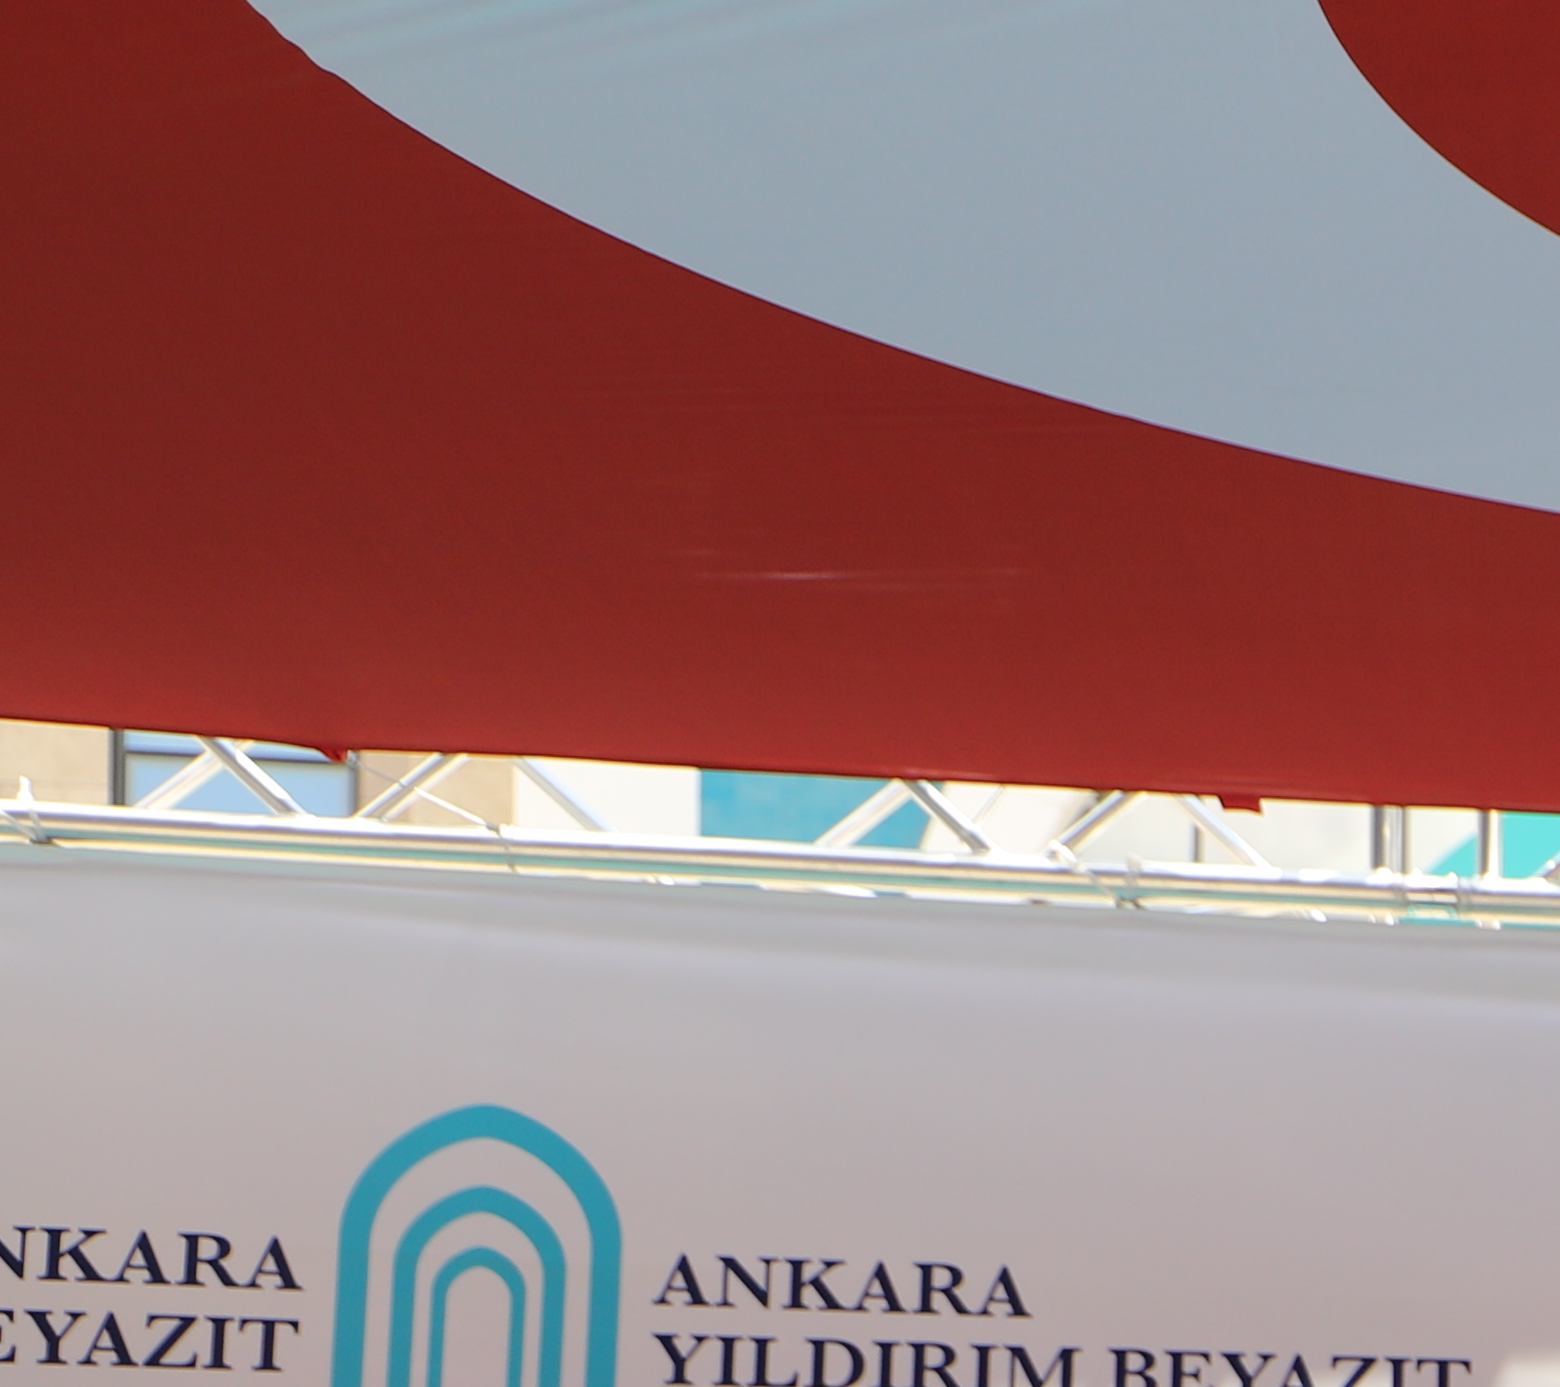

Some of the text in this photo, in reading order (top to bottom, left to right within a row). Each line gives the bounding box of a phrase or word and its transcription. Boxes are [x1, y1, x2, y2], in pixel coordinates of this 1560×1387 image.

[0, 1224, 304, 1291] NKARA
[651, 1251, 1034, 1319] ANKARA
[0, 1307, 301, 1372] YAZIT
